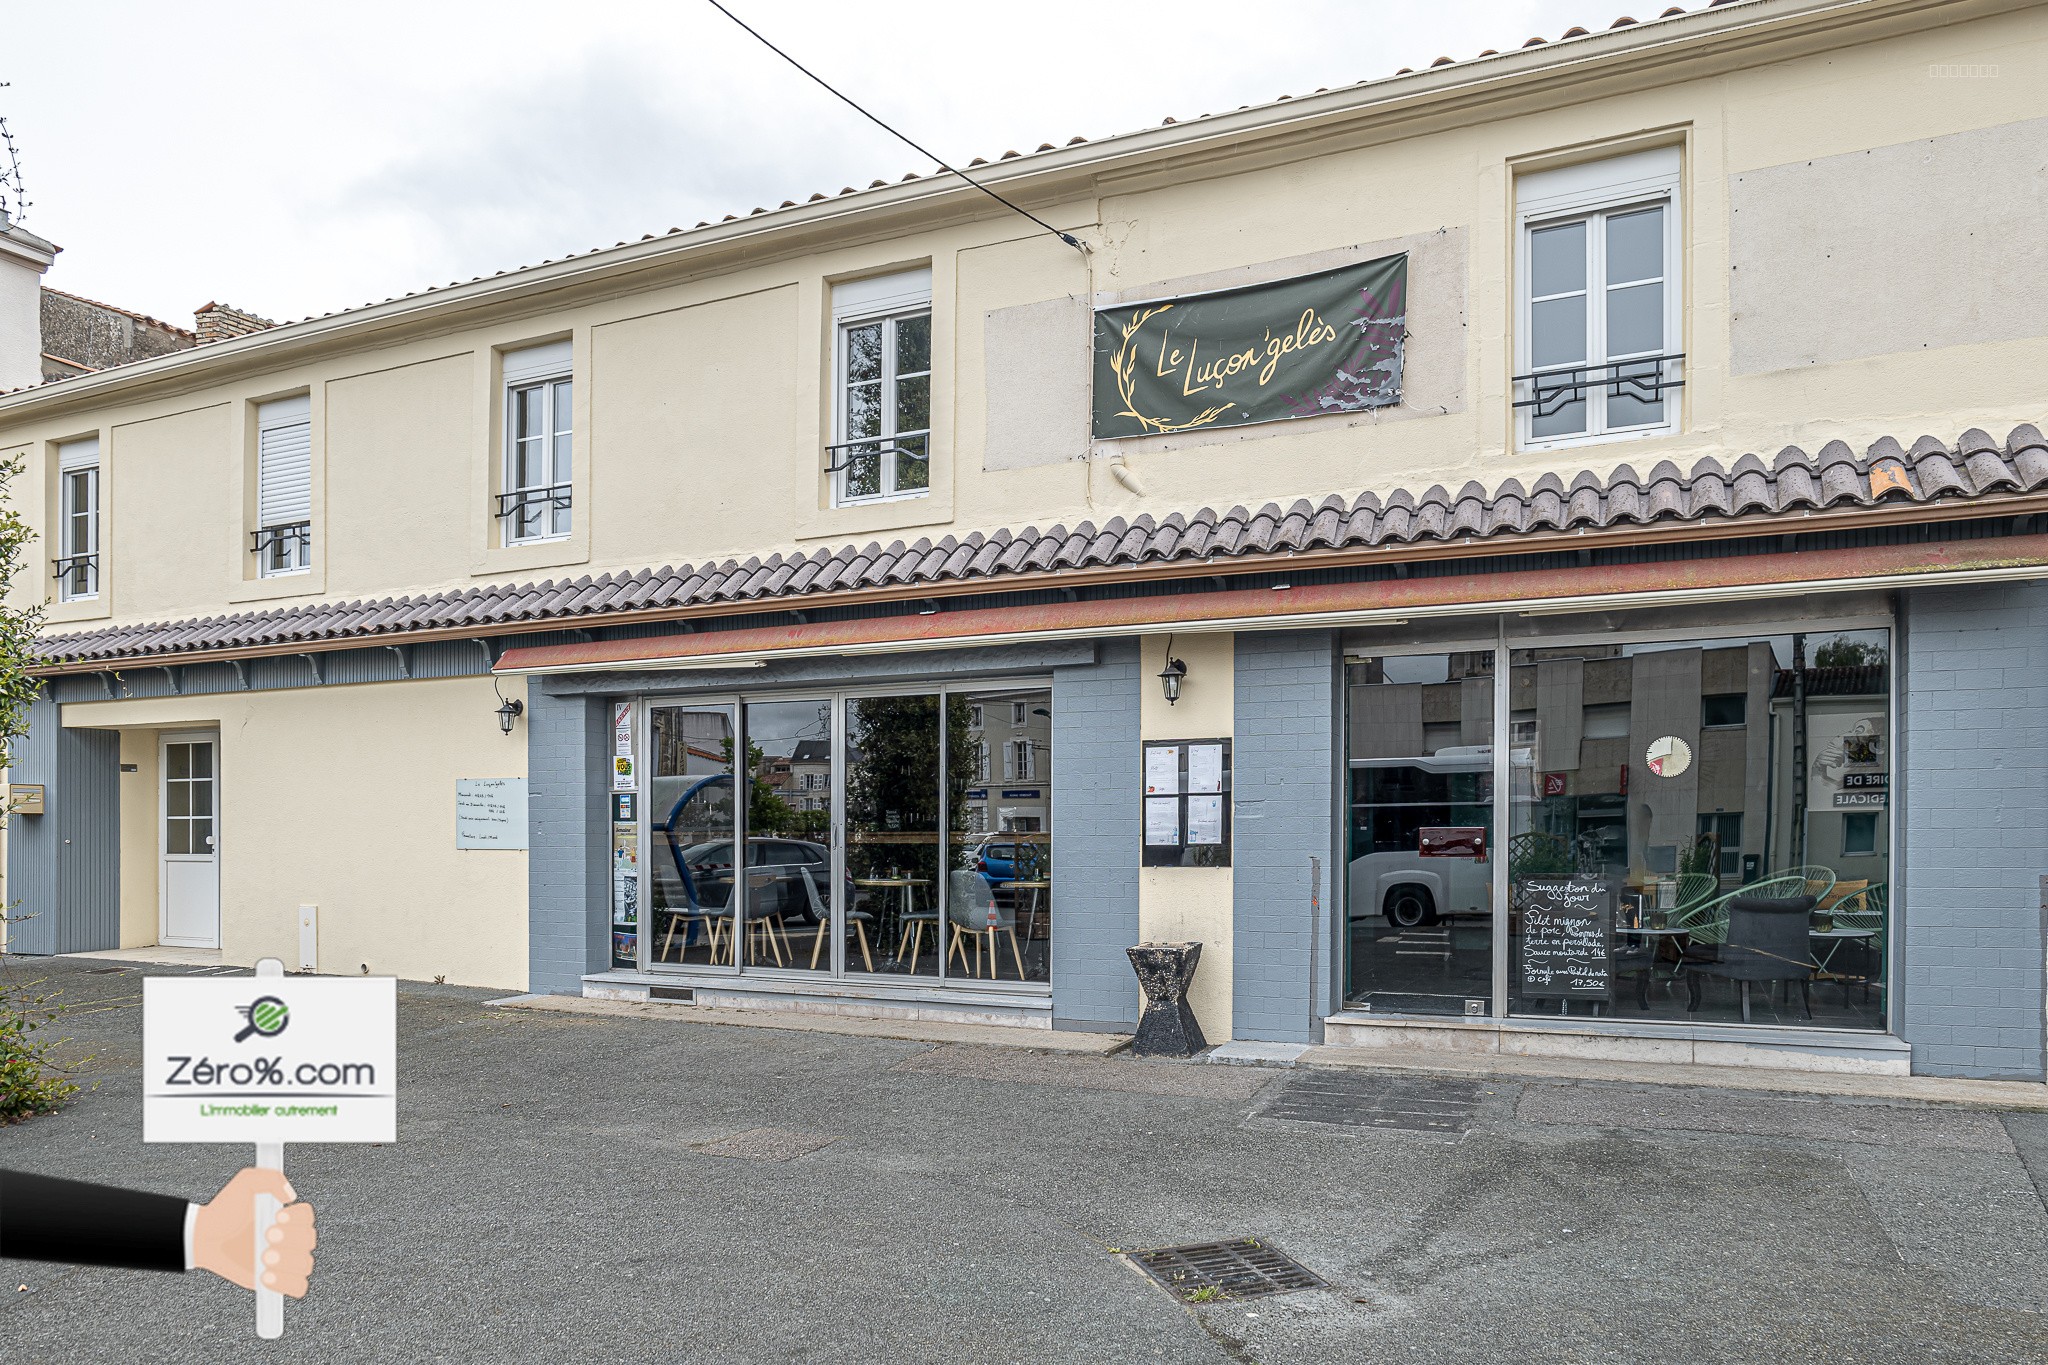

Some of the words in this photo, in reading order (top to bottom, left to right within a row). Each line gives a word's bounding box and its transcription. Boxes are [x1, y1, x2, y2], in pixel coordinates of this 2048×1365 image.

[1156, 329, 1184, 377] Le
[1591, 883, 1606, 893] du
[1563, 893, 1590, 908] jour
[1524, 909, 1551, 926] Filet
[1553, 917, 1591, 927] mignon
[1526, 924, 1538, 934] de
[1525, 935, 1549, 945] terre
[1523, 945, 1550, 957] Sauce
[1552, 947, 1589, 956] moutarde
[1591, 948, 1606, 957] 14€
[1522, 964, 1555, 975] Formule
[1537, 975, 1552, 986] café
